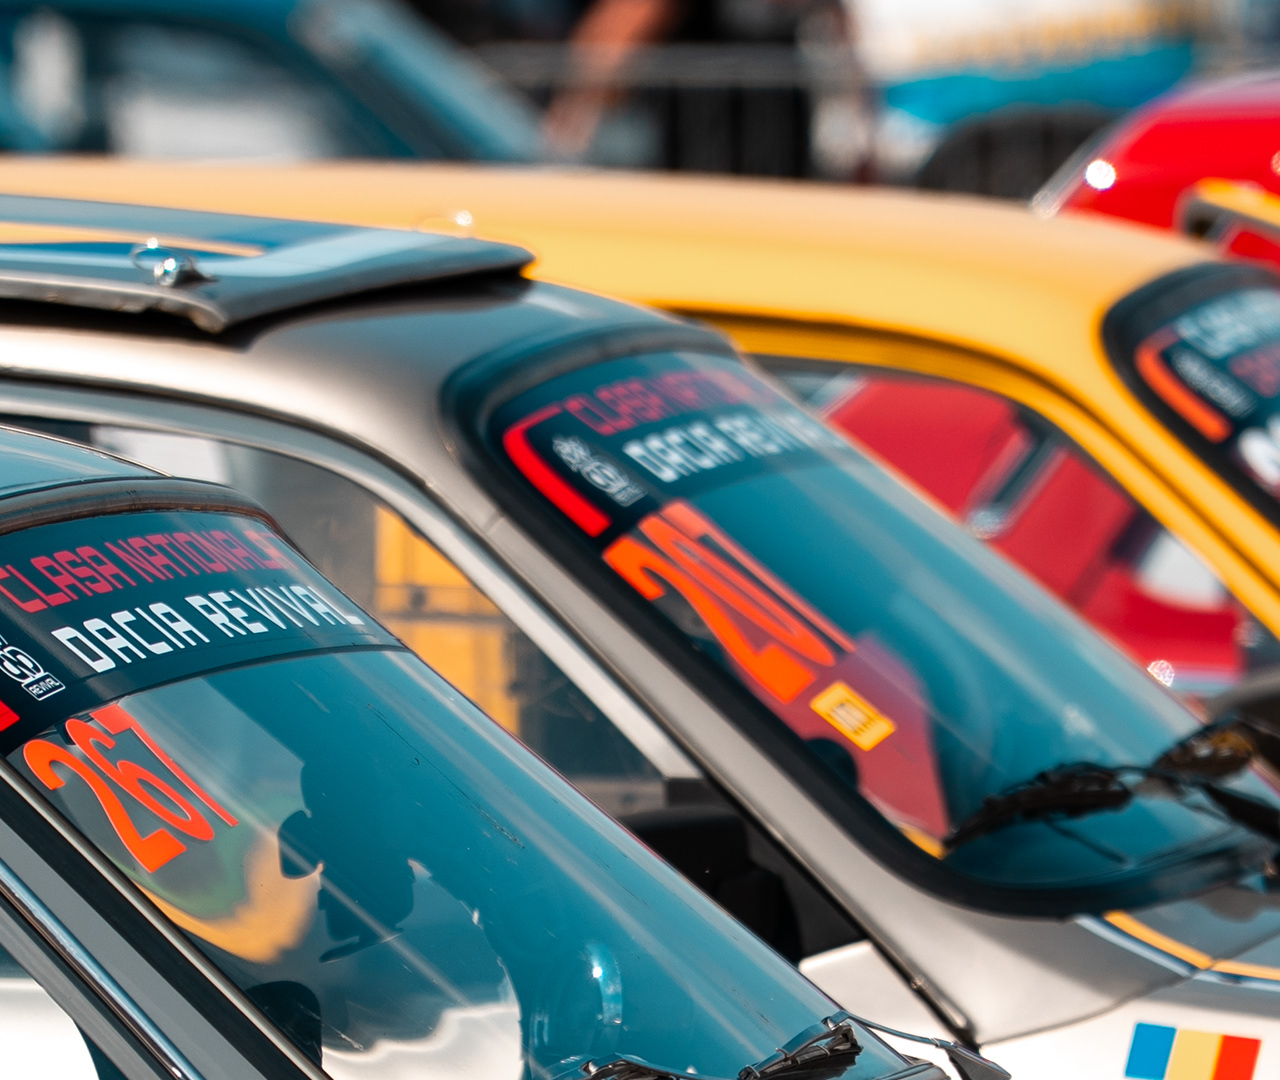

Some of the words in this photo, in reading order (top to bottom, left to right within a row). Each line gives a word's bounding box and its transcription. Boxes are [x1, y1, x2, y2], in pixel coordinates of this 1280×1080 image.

[622, 419, 745, 483] DACIA
[105, 529, 299, 587] NATIONALA
[602, 500, 856, 704] 207
[51, 602, 210, 674] DACIA
[185, 585, 365, 638] REVIVAL
[23, 703, 240, 874] 267
